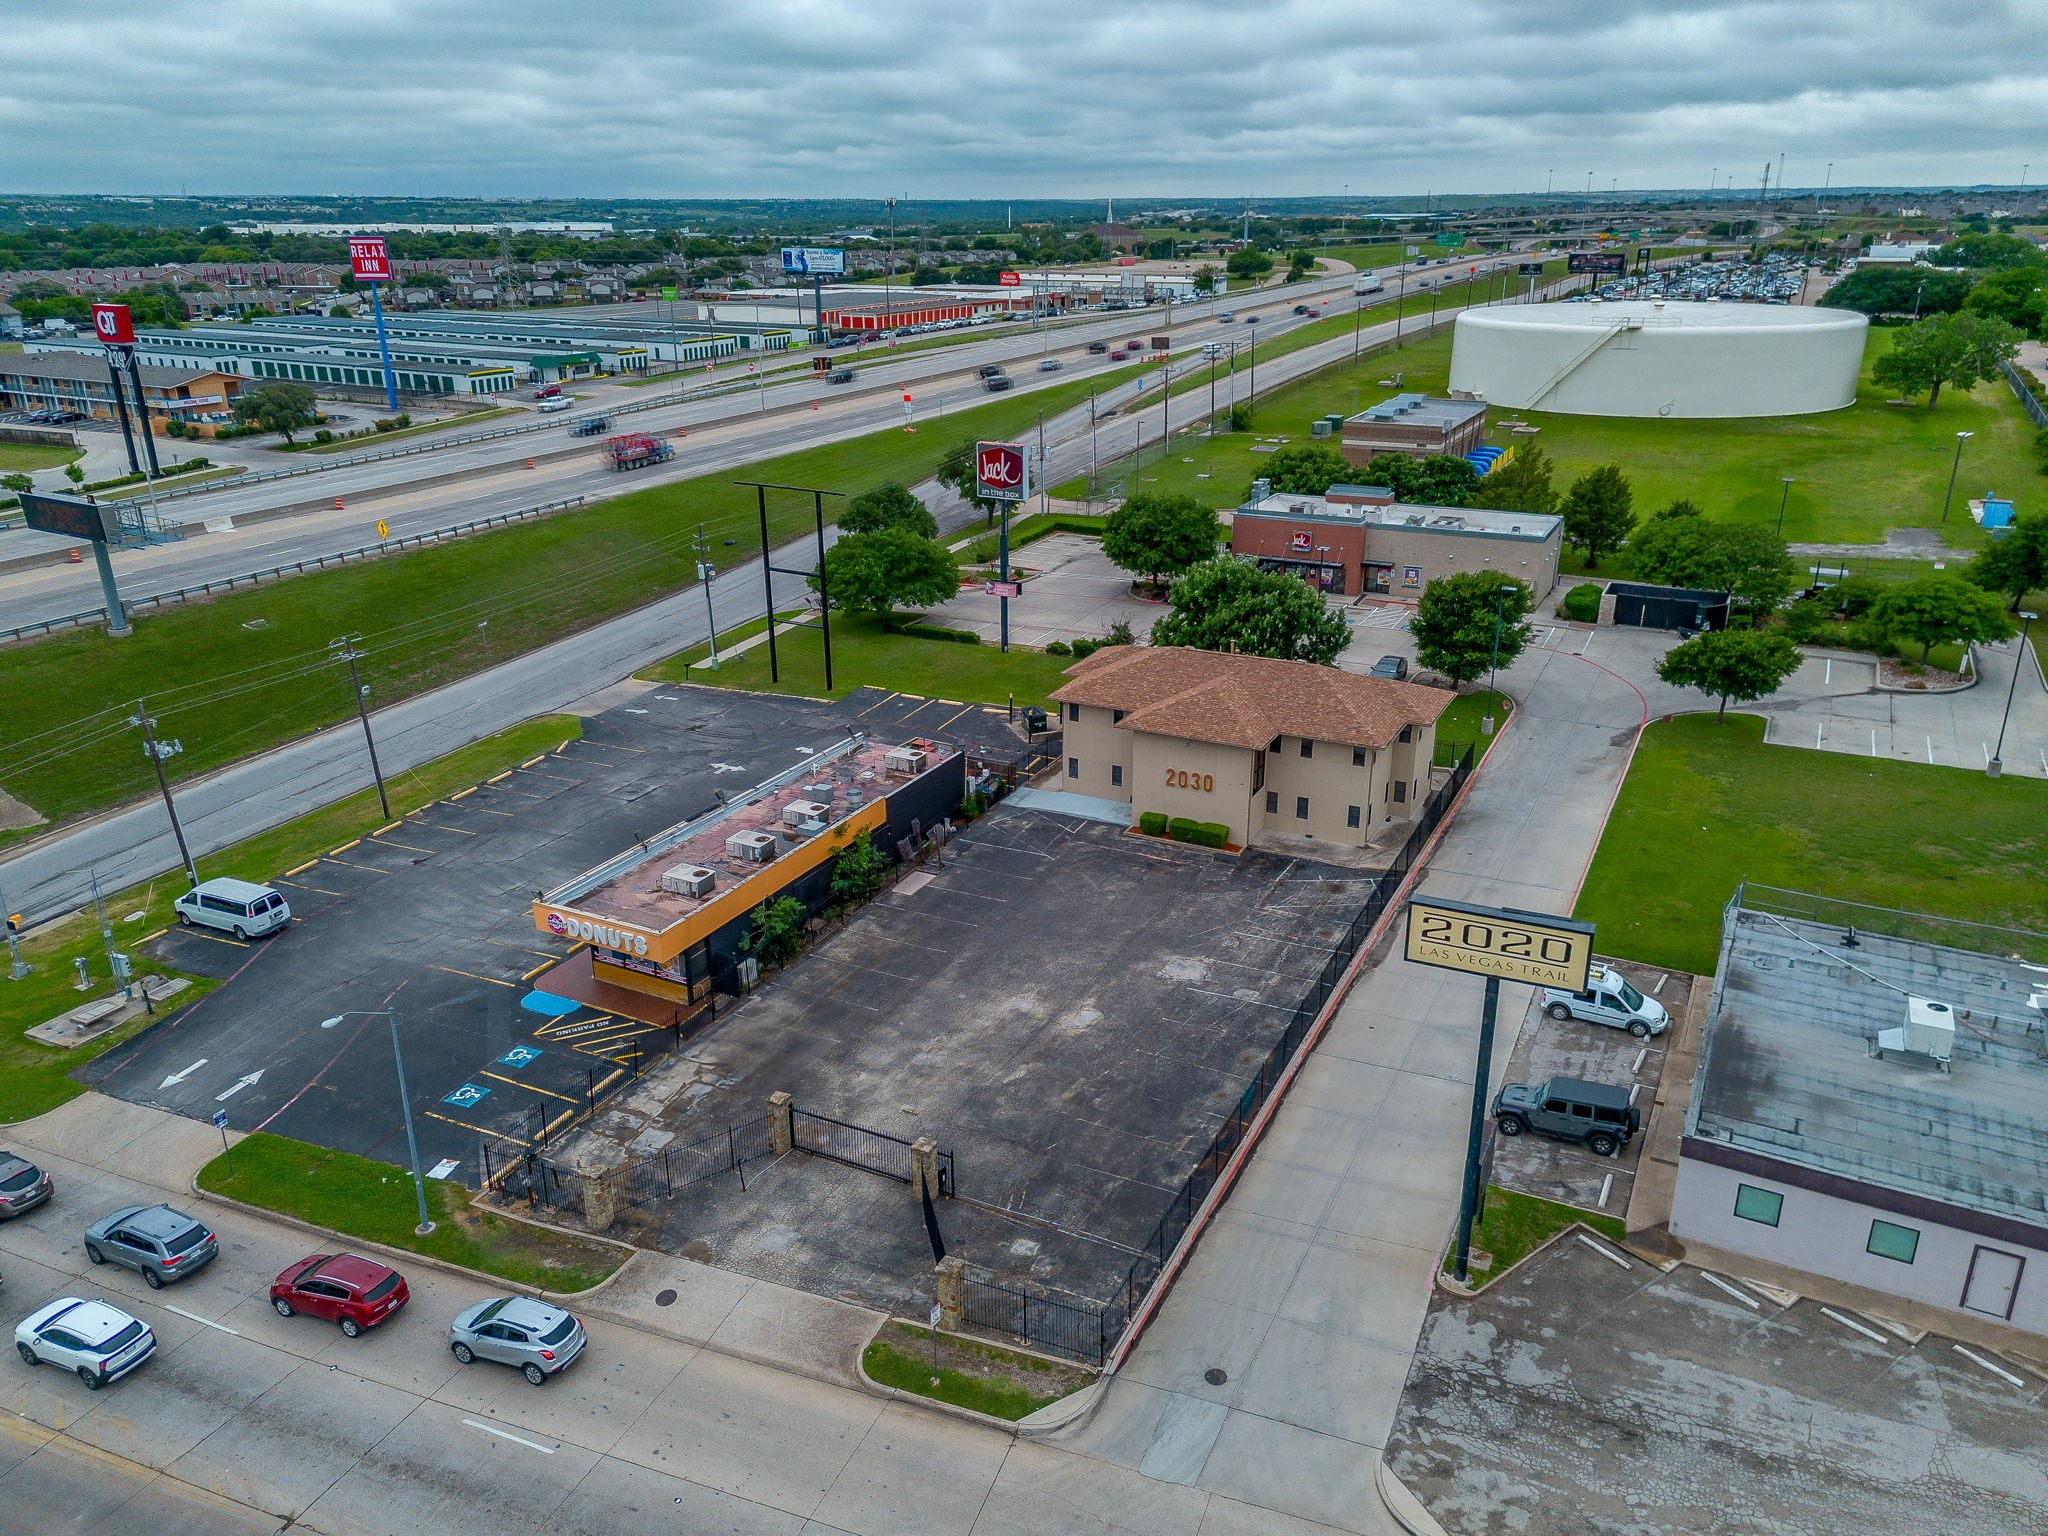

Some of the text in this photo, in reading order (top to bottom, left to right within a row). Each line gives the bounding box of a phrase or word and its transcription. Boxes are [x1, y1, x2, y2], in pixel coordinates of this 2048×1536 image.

[350, 245, 386, 258] RELAX
[361, 259, 380, 272] INN
[96, 310, 116, 336] QT
[980, 452, 1021, 484] Jack
[991, 489, 1004, 497] the
[1292, 534, 1310, 547] Jack
[1165, 767, 1214, 793] 2030
[566, 917, 648, 956] DONUTS
[1421, 916, 1573, 964] 2020
[1420, 946, 1570, 983] LAS VEGAS TRAIL
[555, 1024, 595, 1036] PARKING
